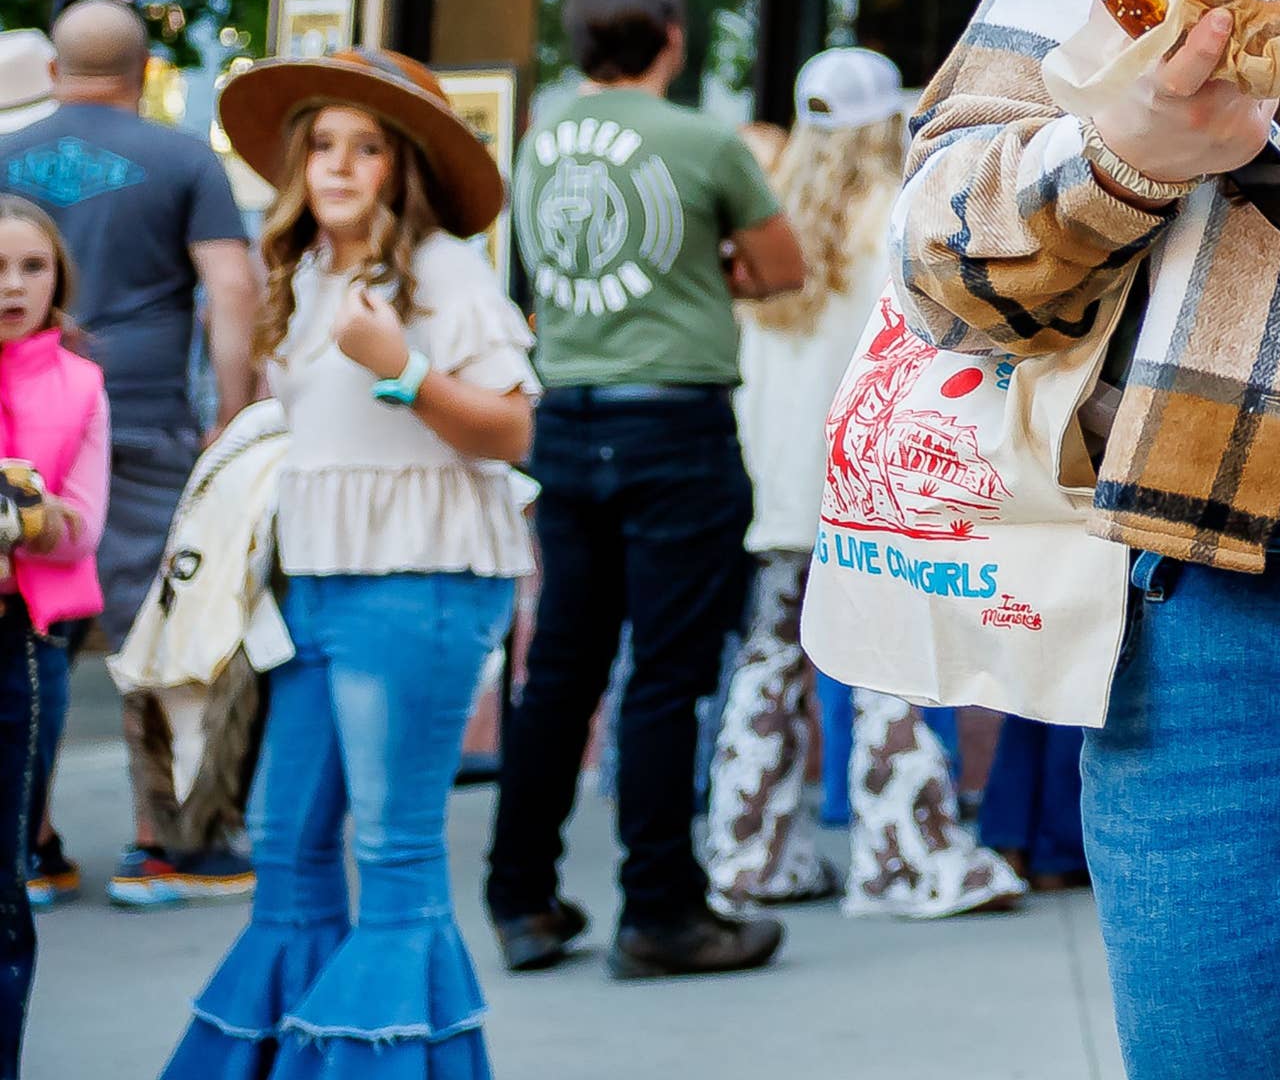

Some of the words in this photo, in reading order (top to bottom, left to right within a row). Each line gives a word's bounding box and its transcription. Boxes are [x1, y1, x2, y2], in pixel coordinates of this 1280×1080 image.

[834, 533, 882, 575] LIVE
[885, 544, 999, 600] COWGIRLS
[997, 593, 1033, 613] Ian
[980, 608, 1042, 631] Munsick
